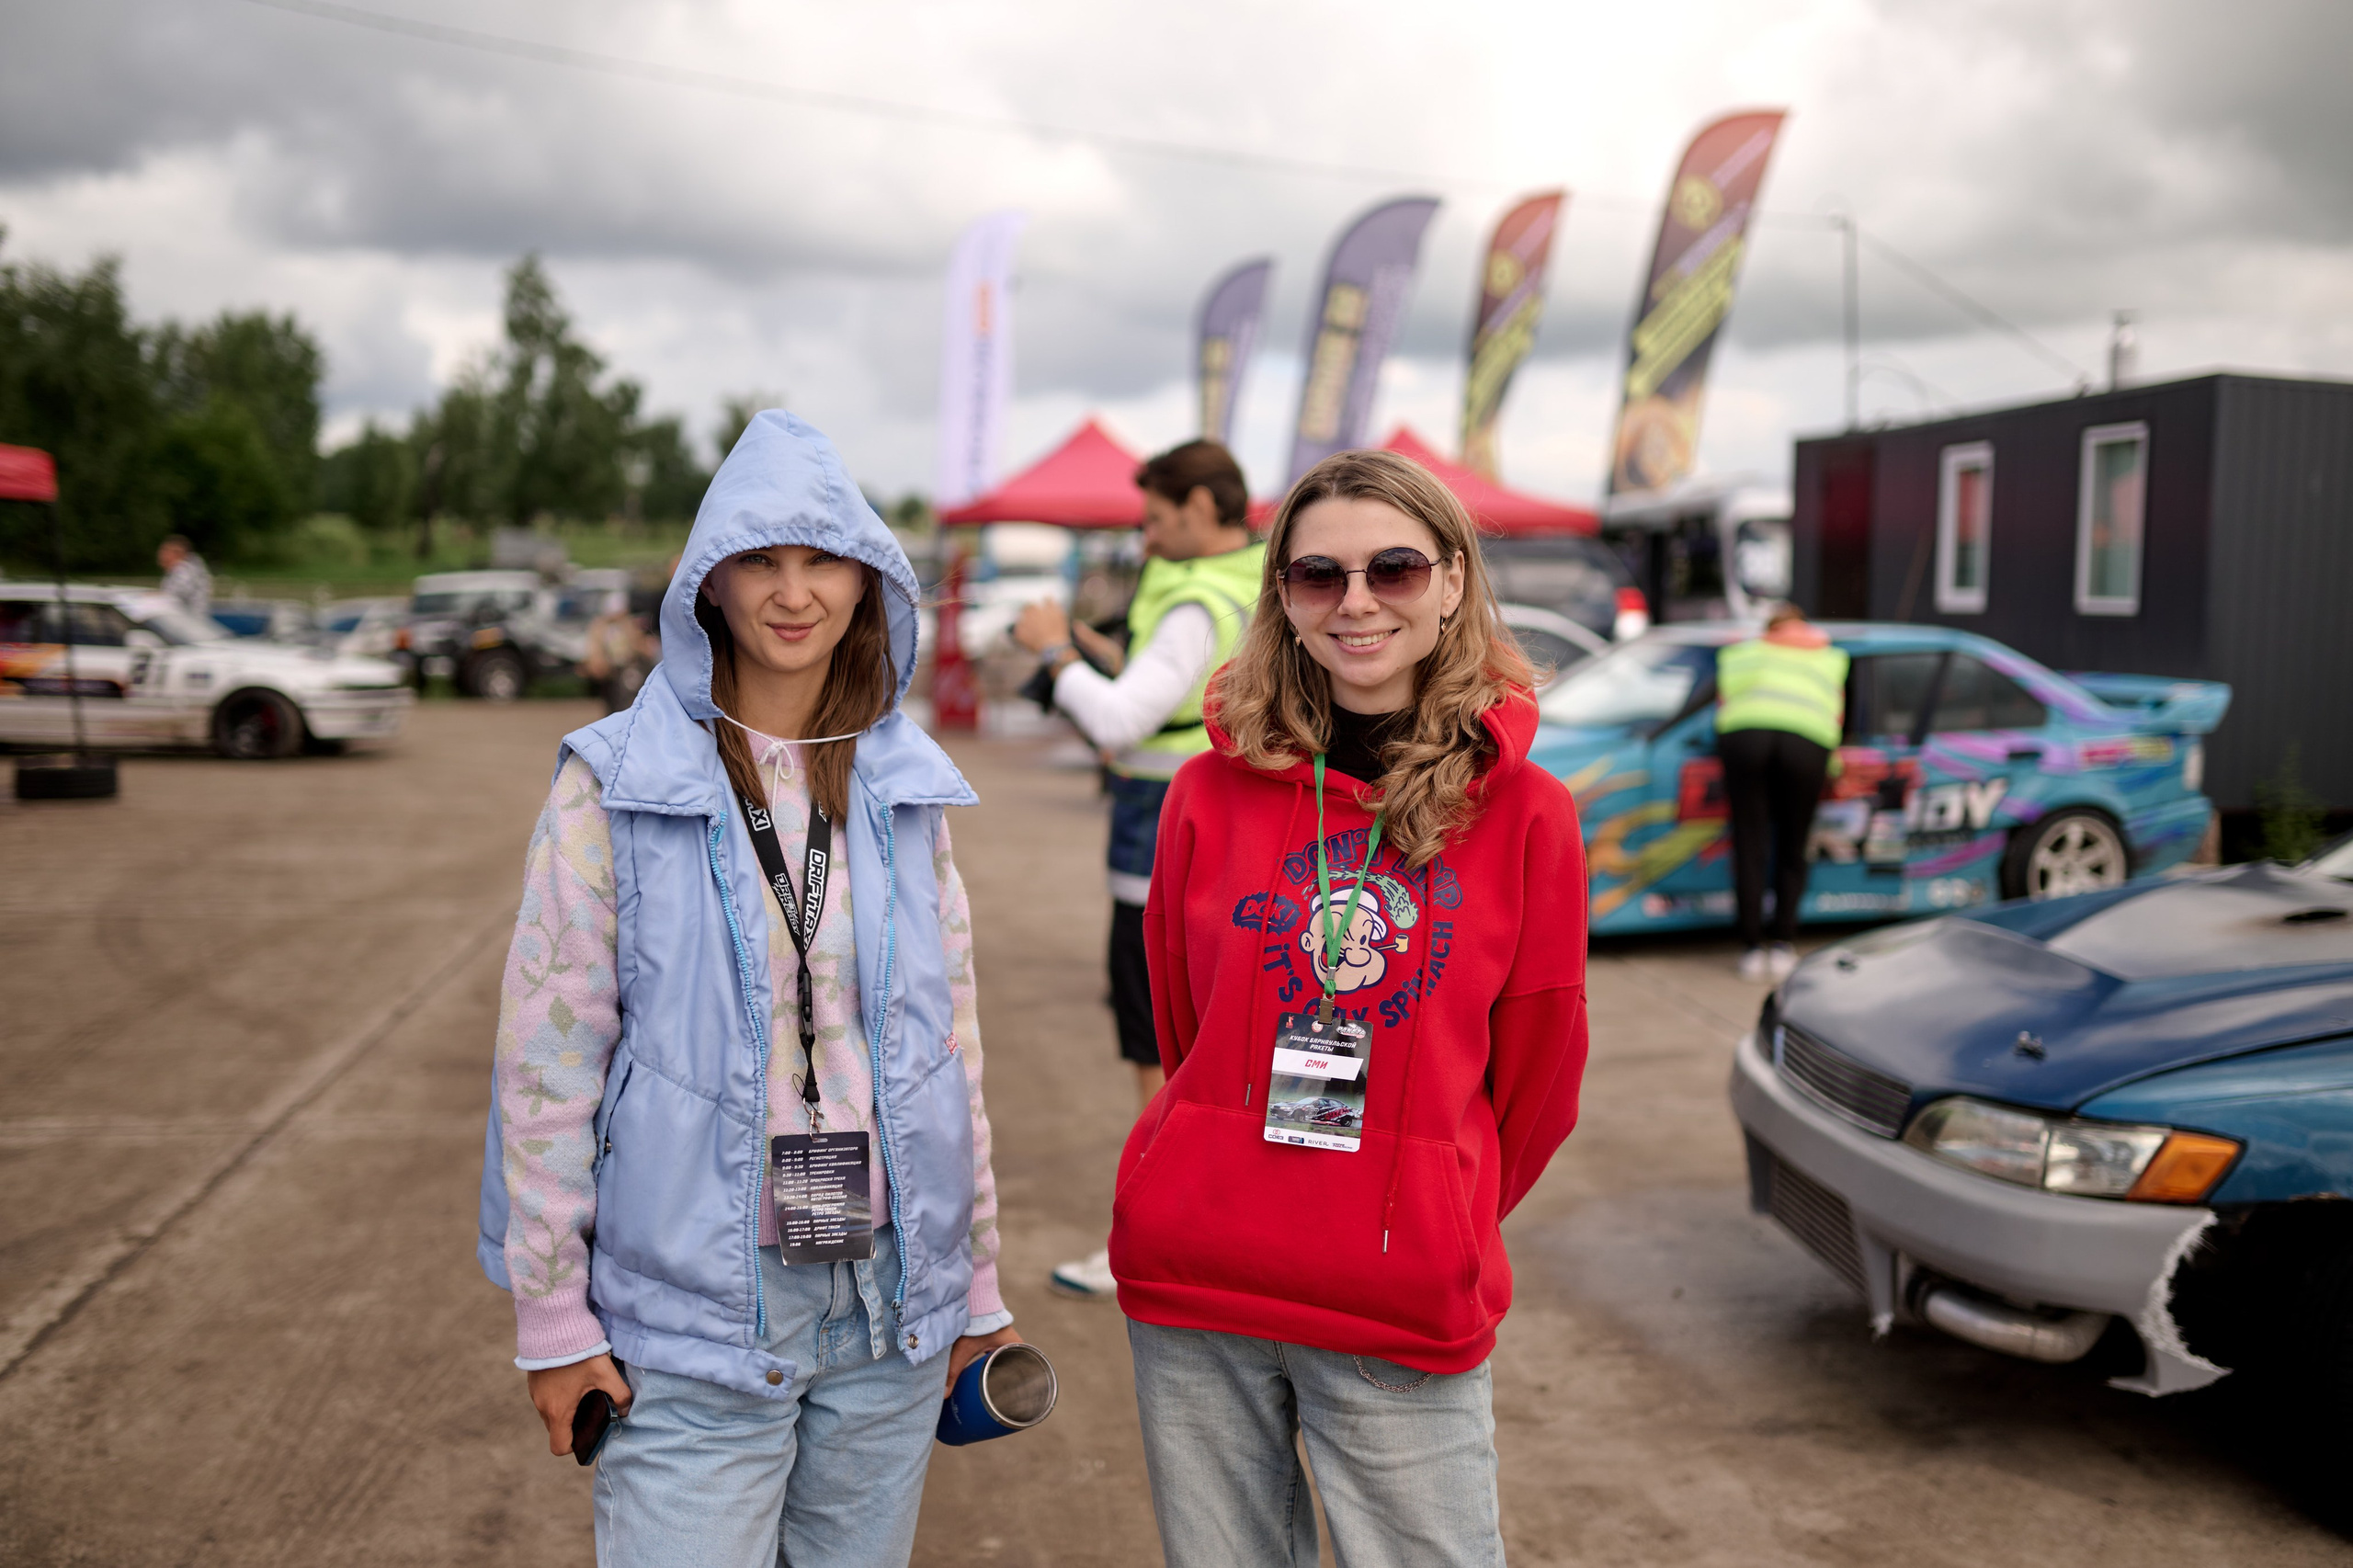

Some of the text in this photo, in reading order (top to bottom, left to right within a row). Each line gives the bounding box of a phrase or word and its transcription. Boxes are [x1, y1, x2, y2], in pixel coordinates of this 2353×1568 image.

[803, 848, 826, 950] DRIFTTAXI
[1309, 1038, 1358, 1049] БАРНАУЛЬСКОЙ
[1309, 1044, 1335, 1052] РАКЕТЫ
[1304, 1059, 1329, 1070] СМИ
